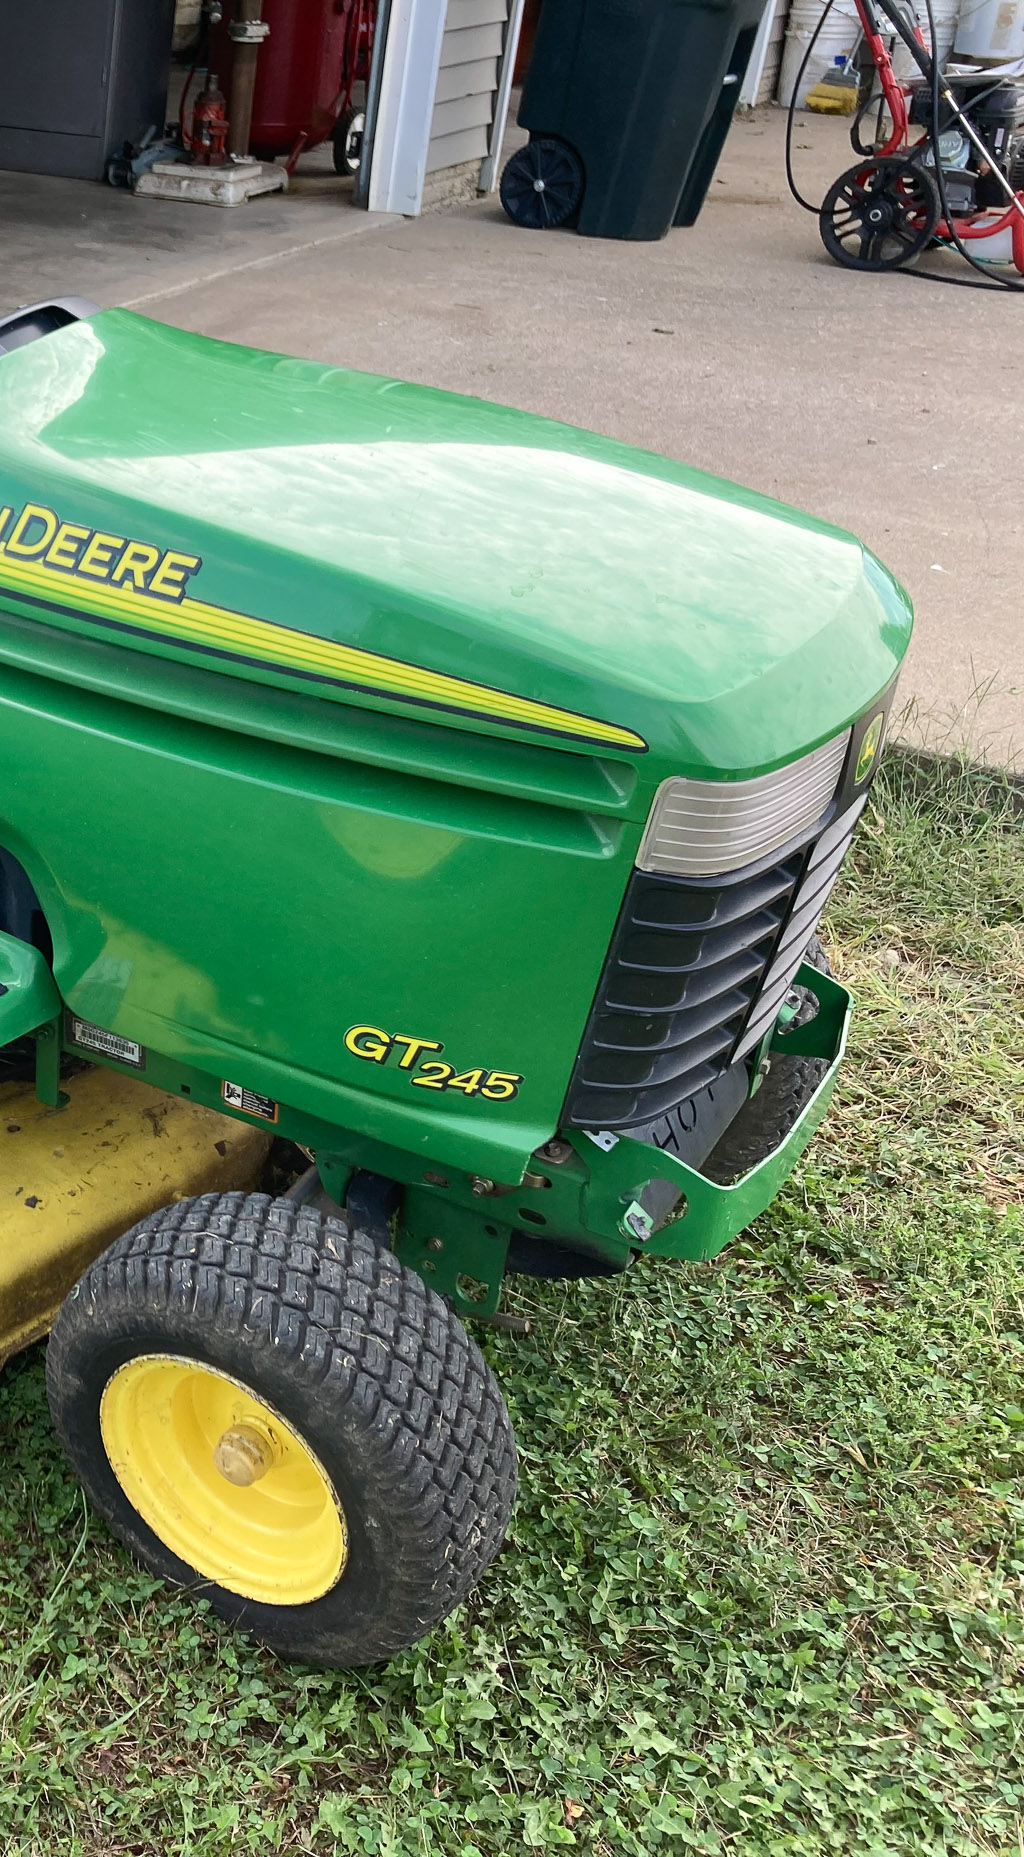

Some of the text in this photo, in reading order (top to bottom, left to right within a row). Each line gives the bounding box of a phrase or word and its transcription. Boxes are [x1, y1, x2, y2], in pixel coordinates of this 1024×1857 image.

[5, 503, 201, 603] DEERE
[344, 1025, 443, 1070] GT
[412, 1061, 523, 1101] 245
